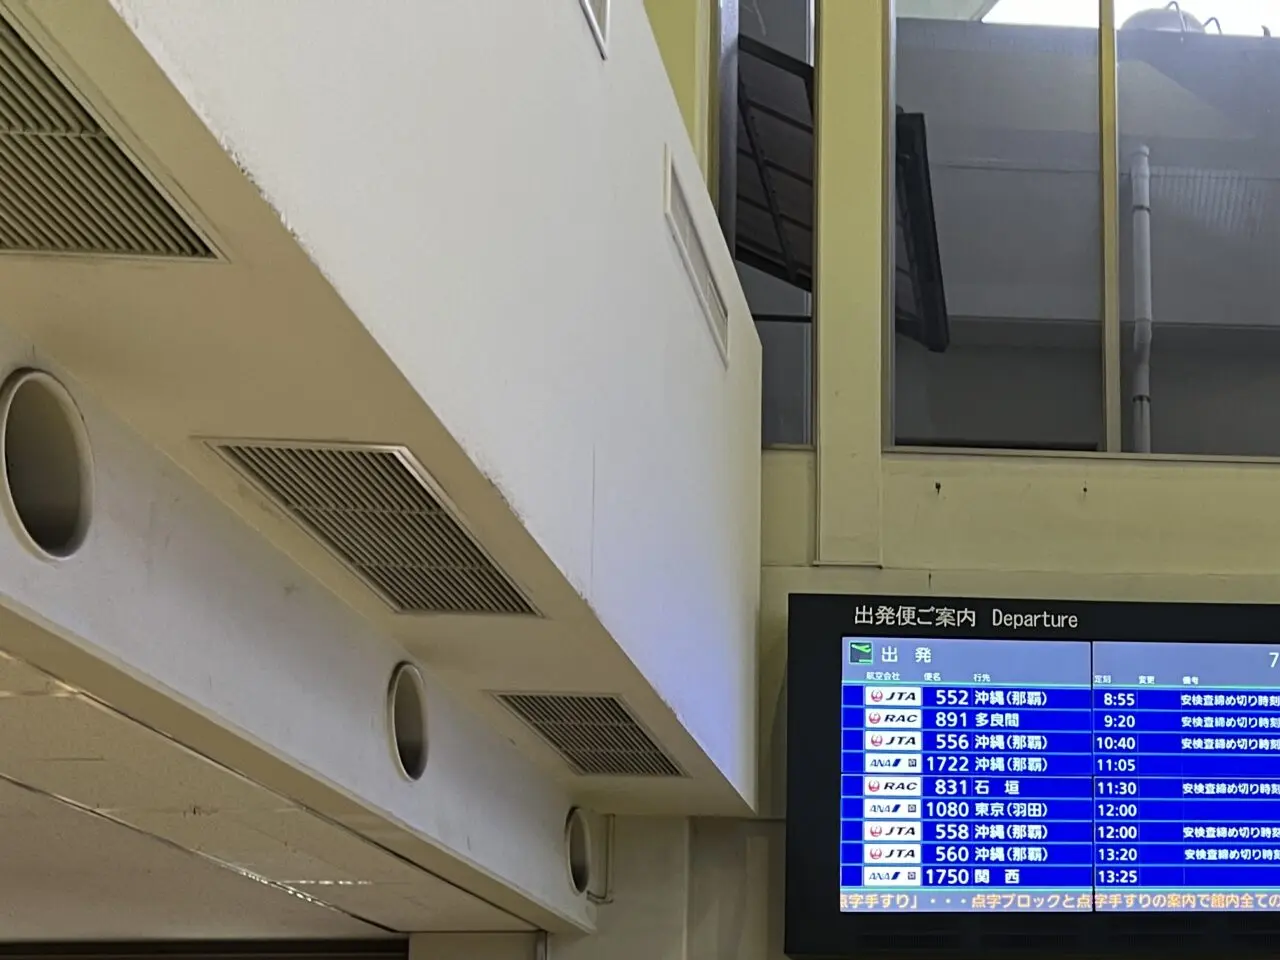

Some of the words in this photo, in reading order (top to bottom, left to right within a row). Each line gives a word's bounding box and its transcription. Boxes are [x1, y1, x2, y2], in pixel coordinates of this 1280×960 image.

[854, 606, 976, 627] 出発便ご案内
[992, 609, 1078, 629] Departure
[882, 646, 932, 663] 出発
[866, 672, 901, 682] 航空会社
[924, 673, 942, 682] 便名
[973, 673, 991, 683] 行先
[886, 692, 916, 701] JTA
[936, 690, 969, 705] 552
[1103, 693, 1135, 706] 8:55
[884, 714, 918, 723] RAC
[935, 712, 968, 727] 891
[975, 713, 1019, 727] 多良間
[1103, 715, 1135, 728] 9:20
[885, 736, 916, 746] JTA
[936, 734, 969, 749] 556
[1096, 737, 1136, 750] 10:40
[926, 757, 969, 772] 1722
[1097, 759, 1136, 772] 11:05
[883, 782, 917, 791] RAC
[935, 780, 968, 795] 831
[974, 780, 1020, 795] 石垣
[1097, 782, 1137, 795] 11:30
[926, 802, 969, 817] 1080
[1098, 804, 1137, 817] 12:00
[885, 826, 916, 836] JTA
[935, 824, 969, 839] 558
[1098, 826, 1137, 839] 12:00
[885, 849, 916, 858] JTA
[935, 847, 969, 862] 560
[1098, 848, 1137, 861] 13:20
[925, 869, 969, 884] 1750
[974, 869, 1020, 884] 関西
[1098, 870, 1138, 883] 13:25
